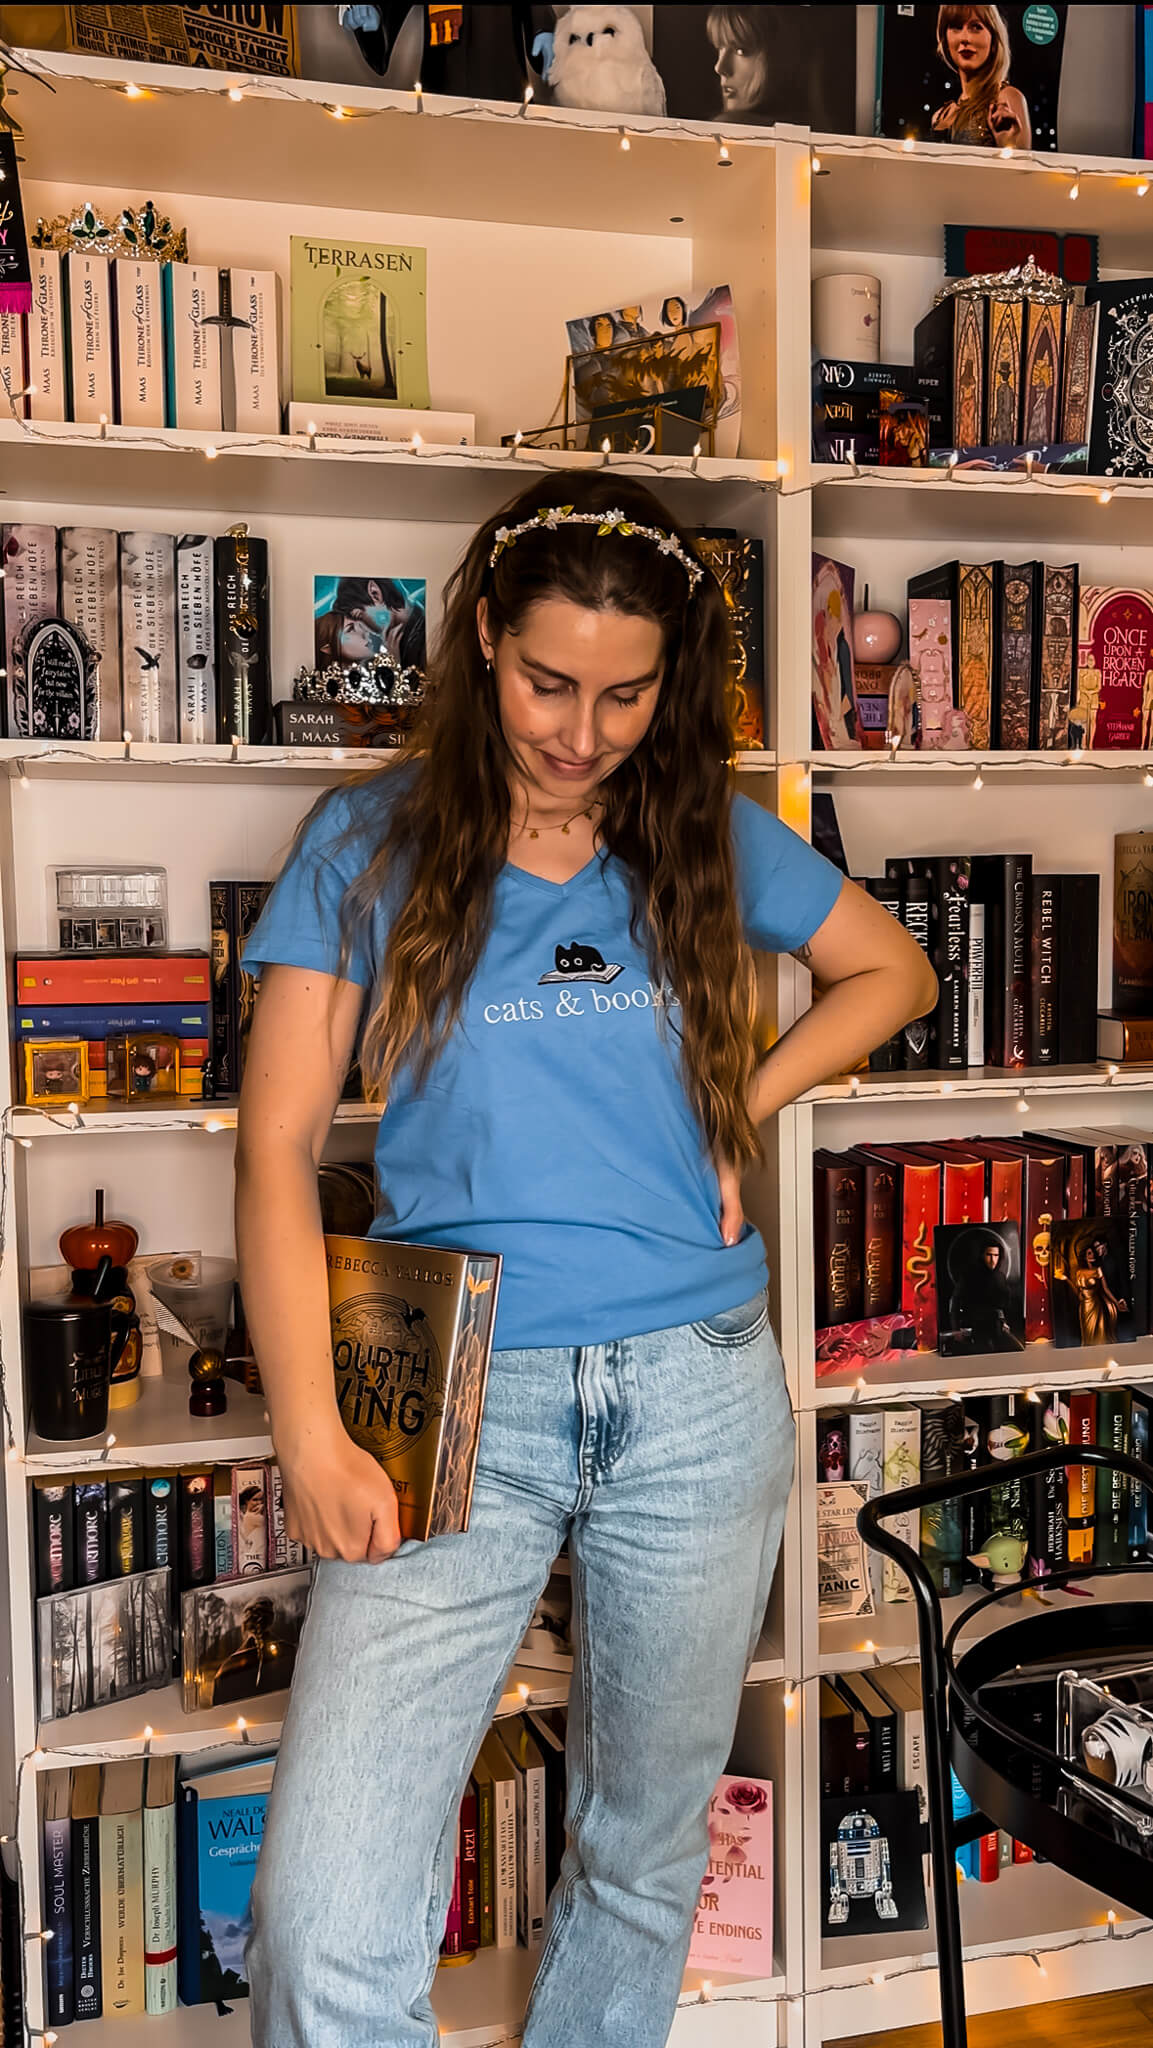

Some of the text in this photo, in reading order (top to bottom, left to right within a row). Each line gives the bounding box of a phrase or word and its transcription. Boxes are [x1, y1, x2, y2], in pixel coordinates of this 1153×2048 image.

[184, 22, 237, 48] MUGGLE
[239, 40, 288, 66] FAMILY
[189, 36, 290, 76] MURDERED
[305, 246, 413, 272] TERRASEN
[35, 273, 50, 358] THRONE of GLASS
[79, 279, 94, 362] THRONE of GLASS
[131, 284, 145, 367] THRONE of GLASS
[188, 288, 201, 369] THRONE of GLASS
[249, 294, 259, 375] THRONE GLASS
[42, 367, 51, 394] MAAS
[87, 372, 96, 399] MAAS
[138, 376, 147, 403] MAAS
[194, 379, 202, 406] MAAS
[252, 384, 260, 410] MAAS
[16, 565, 24, 600] REICH
[190, 552, 202, 582] HÖFE
[28, 577, 38, 618] SIEBEN
[74, 568, 84, 626] DAS REICH
[88, 581, 97, 623] SIEBEN
[134, 571, 142, 608] REICH
[145, 550, 156, 649] DER SIEBEN HÖFE
[181, 574, 189, 610] REICH
[227, 574, 236, 609] REICH
[193, 586, 202, 629] SIEBEN
[1103, 626, 1148, 647] ONCE
[1103, 643, 1132, 658] UPON
[1102, 656, 1146, 674] BROKEN
[1102, 670, 1145, 688] HEART
[187, 685, 196, 722] SARAH
[200, 681, 208, 714] MAAS
[233, 686, 242, 724] SARAH
[289, 713, 334, 725] SARAH
[302, 732, 340, 743] MAAS
[1013, 880, 1024, 934] CRIMSON
[943, 891, 969, 961] Fearless
[1041, 889, 1052, 984] REBEL WITCH
[1013, 937, 1024, 975] MOTH
[484, 996, 544, 1024] cats
[555, 989, 585, 1018] &
[1128, 1227, 1138, 1256] FALLEN
[327, 1254, 455, 1287] REBECCA YARROS
[334, 1340, 431, 1388] OURTH
[822, 1508, 841, 1517] STAR
[1081, 1500, 1089, 1514] DIE
[1112, 1489, 1121, 1510] DIE
[1047, 1511, 1055, 1552] DEBORAH
[1055, 1502, 1063, 1561] HARKNESS
[818, 1578, 860, 1593] TANIC
[912, 1735, 921, 1770] ESCAPE
[223, 1807, 249, 1818] NEALE
[532, 1802, 540, 1826] GROW
[463, 1828, 476, 1863] Jetzt!
[533, 1839, 541, 1865] THINK
[53, 1829, 66, 1914] SOUL MASTER
[115, 1824, 126, 1929] WERDE ÜBERNATÜRLICH
[151, 1865, 161, 1930] Joseph MURPHY
[709, 1922, 763, 1941] ENDINGS
